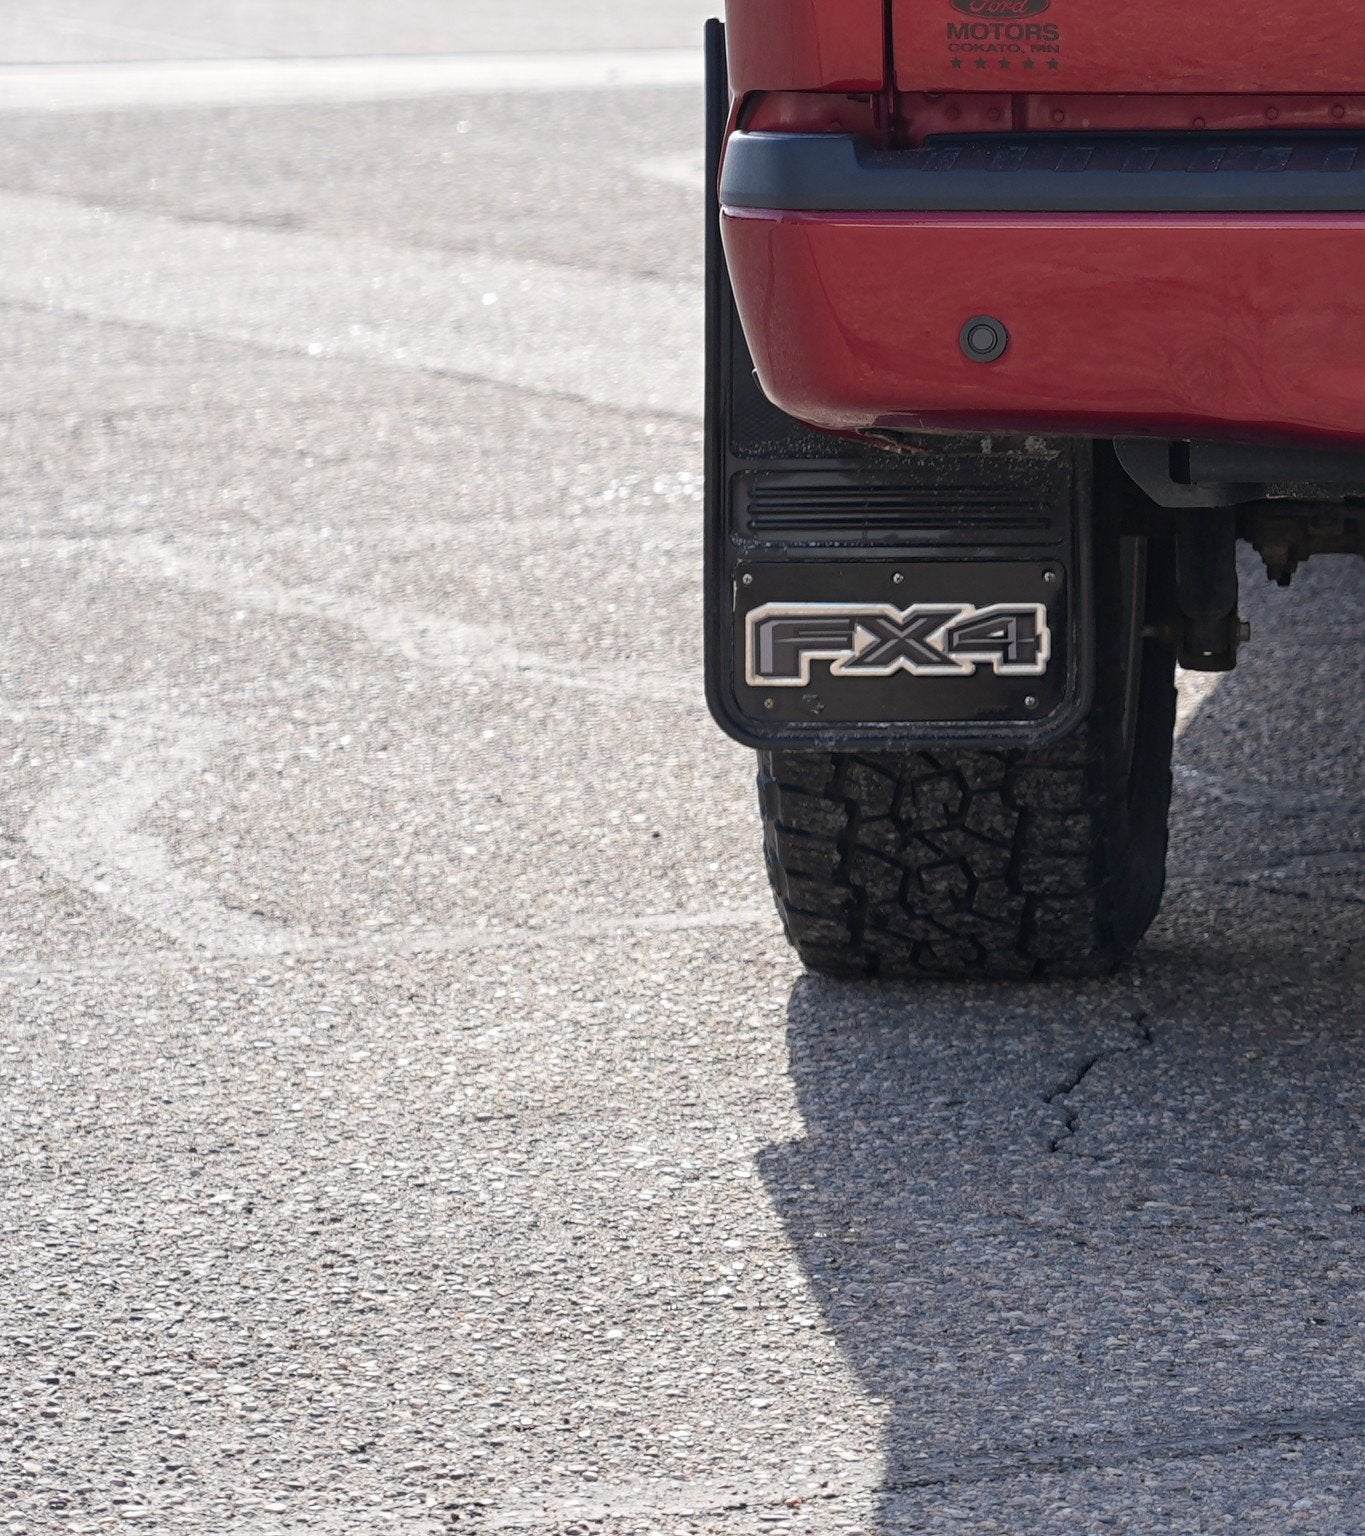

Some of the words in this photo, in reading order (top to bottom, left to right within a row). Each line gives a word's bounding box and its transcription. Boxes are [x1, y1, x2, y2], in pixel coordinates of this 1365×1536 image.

[946, 22, 1061, 42] MOTORS
[1030, 44, 1060, 54] MN
[745, 601, 1052, 687] FX4
